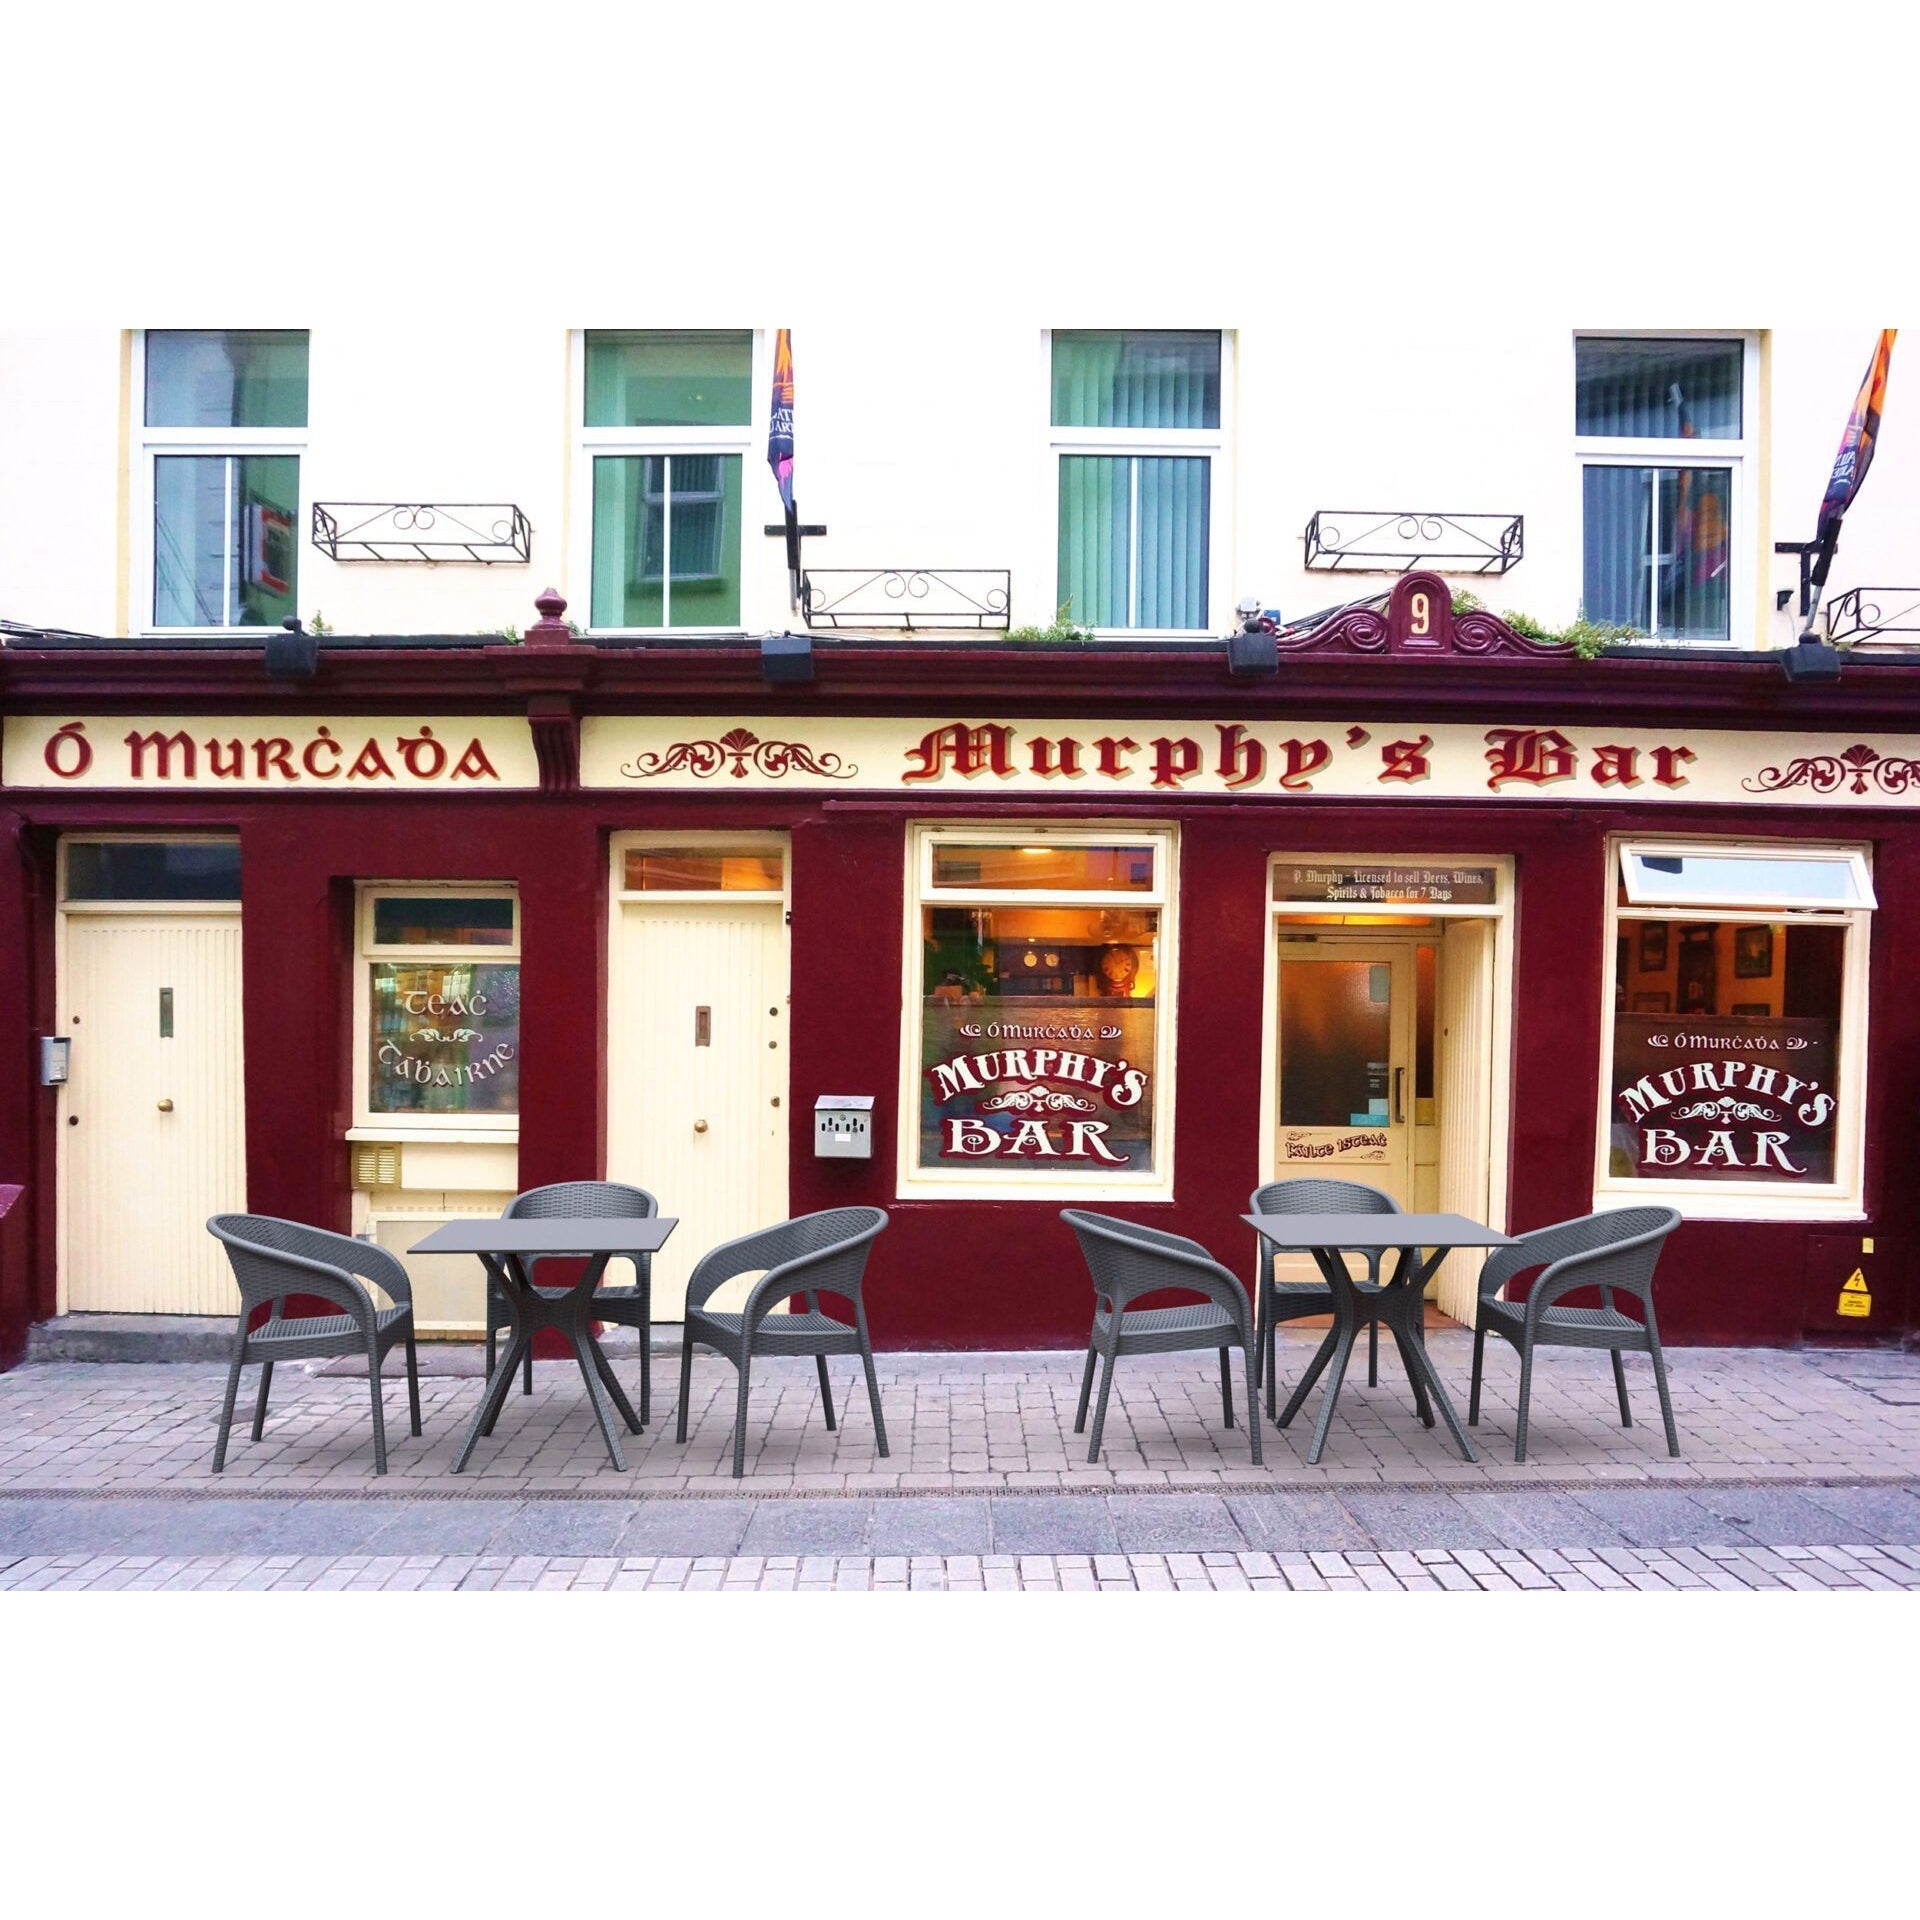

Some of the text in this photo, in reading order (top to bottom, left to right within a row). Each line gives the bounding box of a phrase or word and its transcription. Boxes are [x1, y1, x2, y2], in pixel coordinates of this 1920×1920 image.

[1411, 593, 1430, 634] 9
[43, 721, 93, 778] Ó
[902, 722, 1698, 793] Murphy's Bar
[1306, 870, 1344, 886] Murphy
[1353, 870, 1391, 884] Licensed
[1394, 871, 1404, 884] to
[1405, 870, 1420, 883] sell
[1326, 886, 1453, 902] Spirits & Tobacco for 7 Days
[932, 1049, 1149, 1106] MURPHY'S
[1619, 1061, 1837, 1126] MURPHY'S
[947, 1119, 1130, 1162] BAR
[1641, 1129, 1808, 1173] BAR
